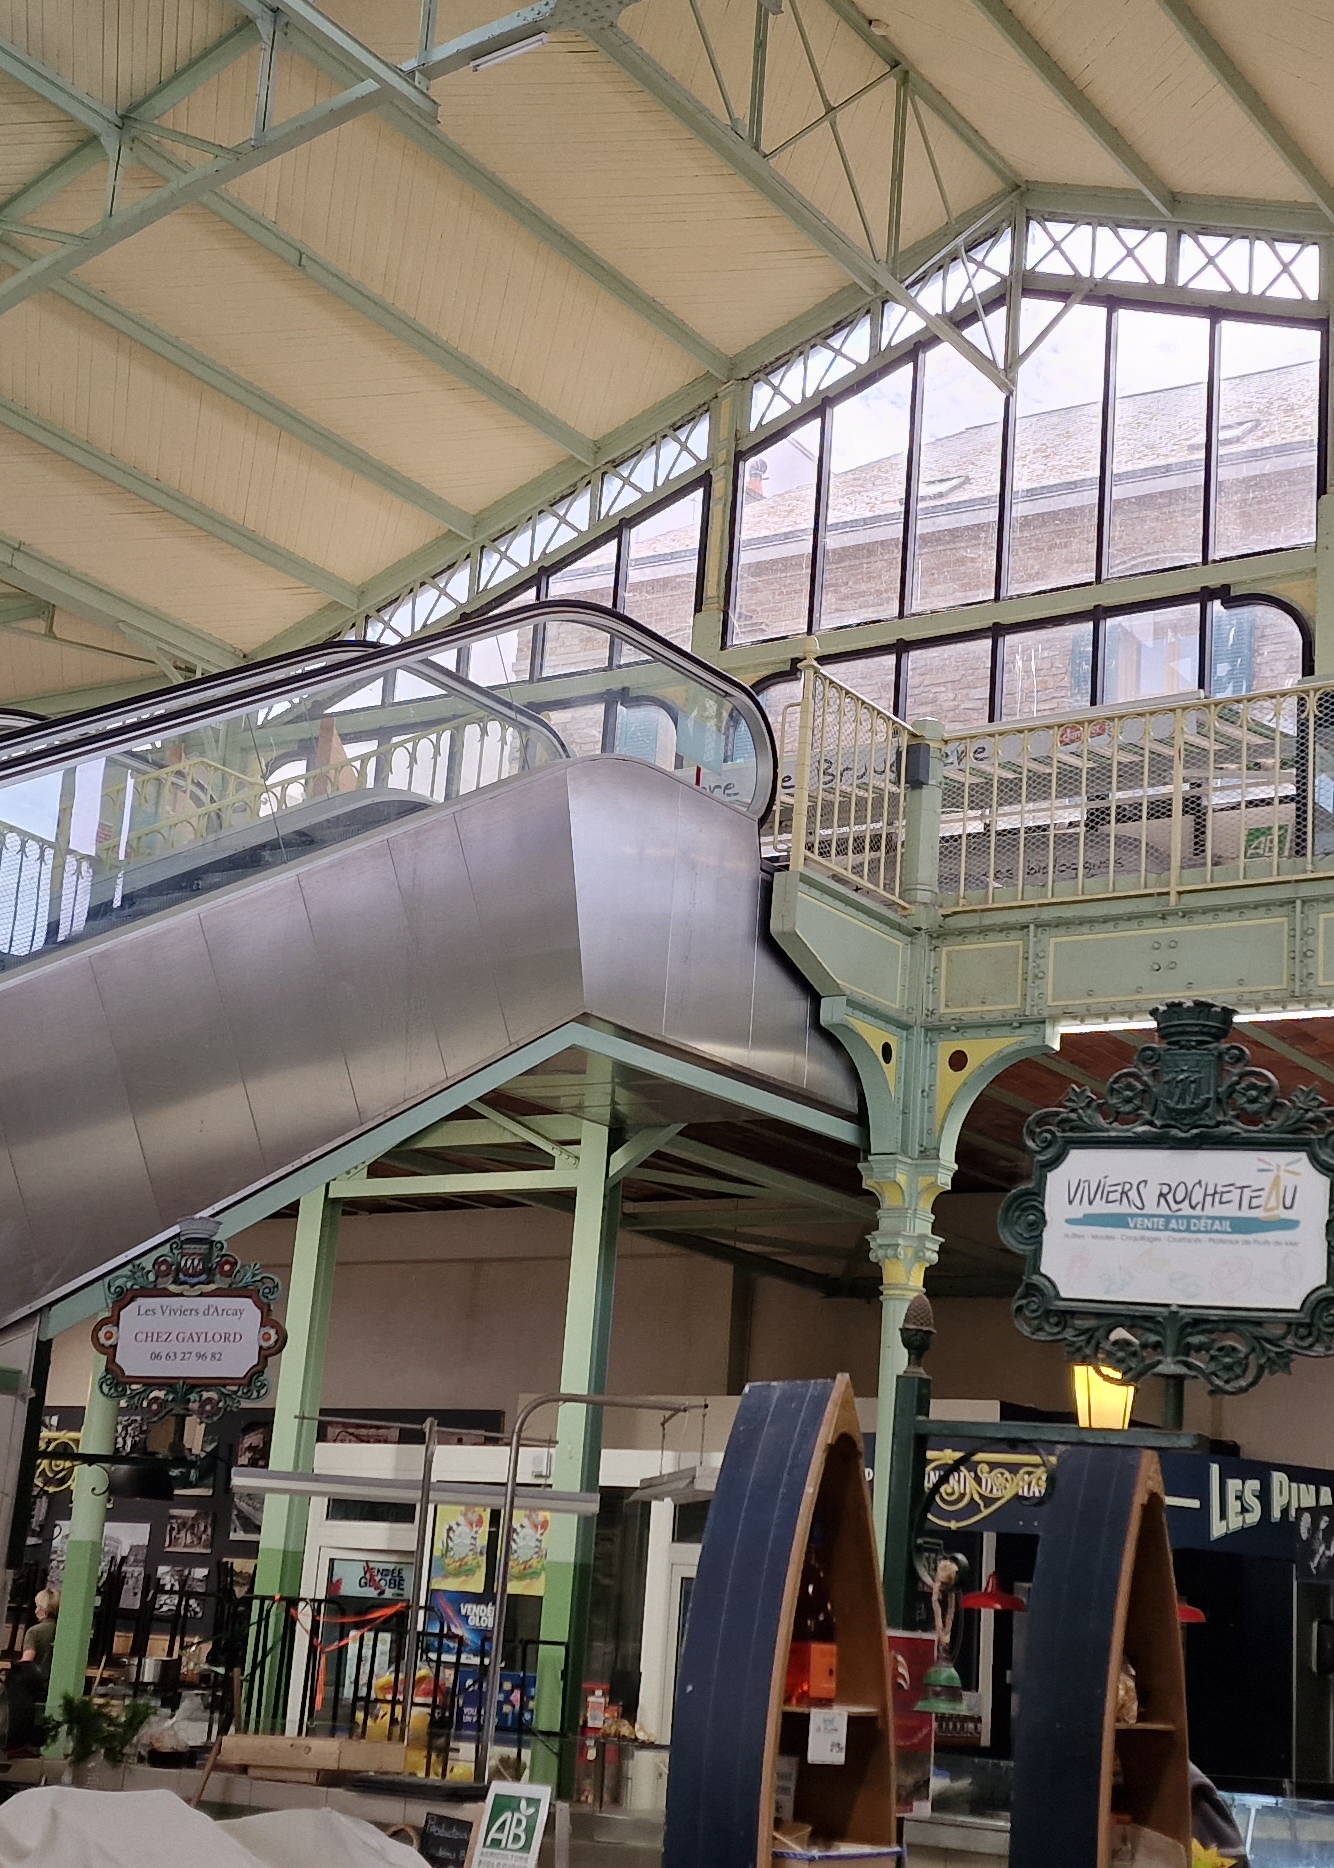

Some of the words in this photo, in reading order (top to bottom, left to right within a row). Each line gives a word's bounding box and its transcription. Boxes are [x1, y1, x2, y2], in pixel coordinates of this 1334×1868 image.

[1067, 1175, 1148, 1211] VIVIERS
[1128, 1217, 1165, 1230] VENTE
[1169, 1218, 1187, 1230] AU
[1190, 1217, 1233, 1232] DÉTAIL
[137, 1305, 156, 1317] Les
[160, 1304, 199, 1317] Viviers
[134, 1331, 172, 1343] CHEZ
[175, 1331, 243, 1344] GAYLORD
[150, 1352, 163, 1361] 06
[164, 1352, 178, 1361] 63
[180, 1352, 193, 1361] 27
[195, 1352, 208, 1361] 96
[210, 1352, 223, 1361] 82
[1209, 1462, 1261, 1541] LES
[358, 1575, 405, 1591] GLOBE
[460, 1602, 494, 1616] VENDÉ
[467, 1614, 494, 1628] GLOB
[485, 1811, 527, 1850] AB
